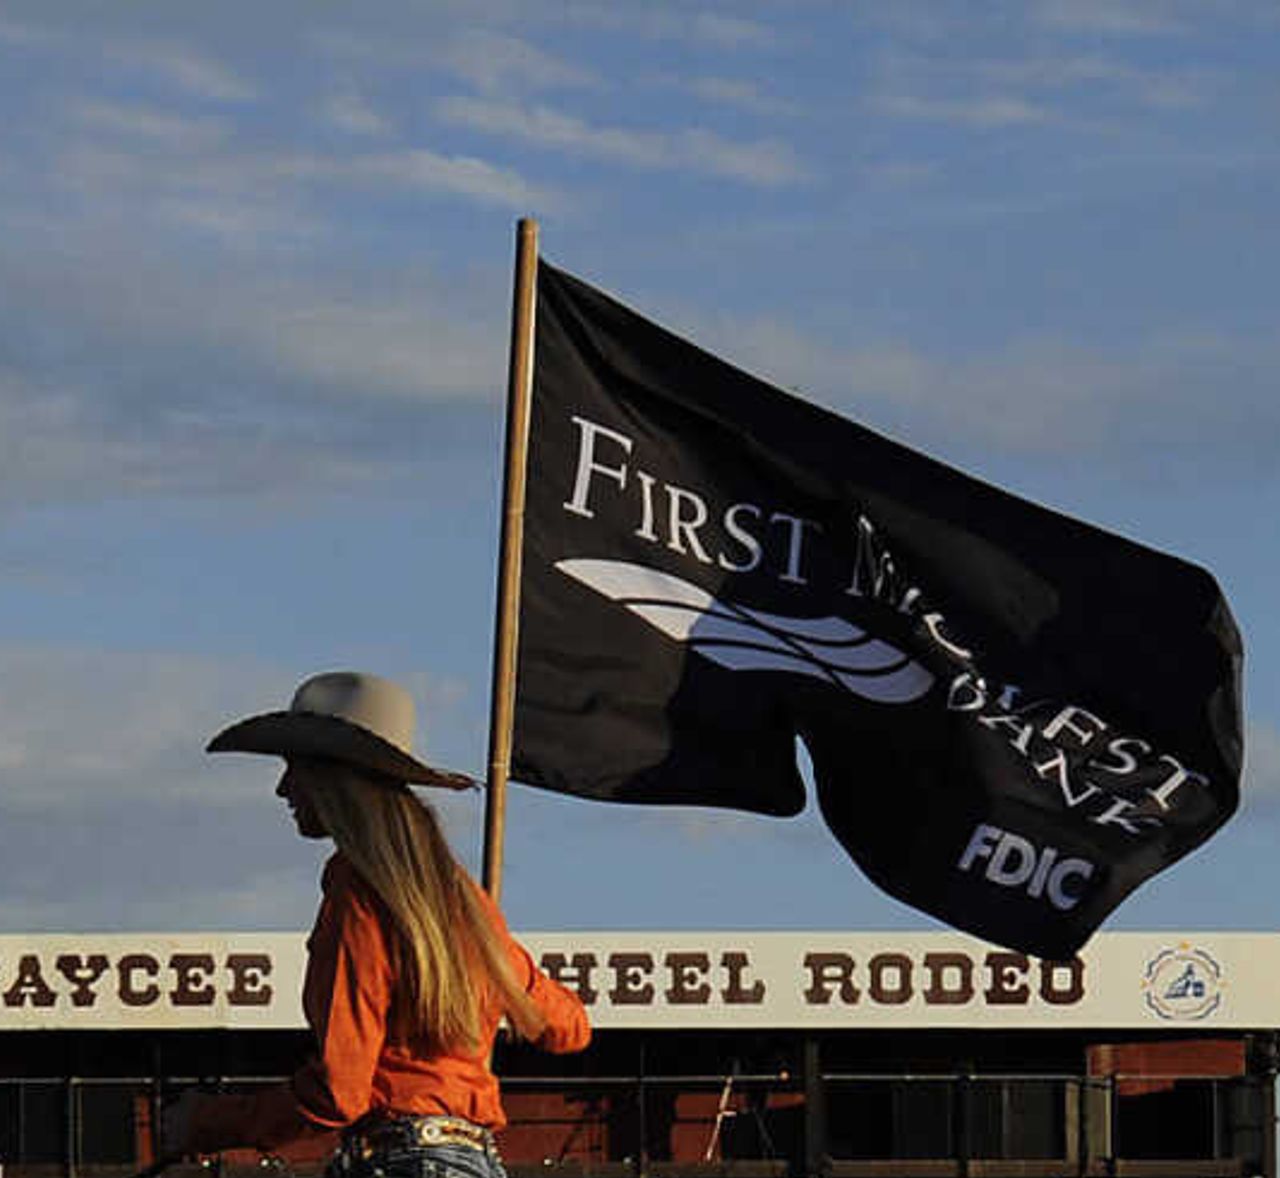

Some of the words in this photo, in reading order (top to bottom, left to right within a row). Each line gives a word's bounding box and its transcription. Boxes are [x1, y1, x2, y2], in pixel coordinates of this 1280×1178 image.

[562, 416, 825, 586] FIRST
[956, 825, 1098, 911] FDIC
[802, 951, 1088, 1006] RODEO
